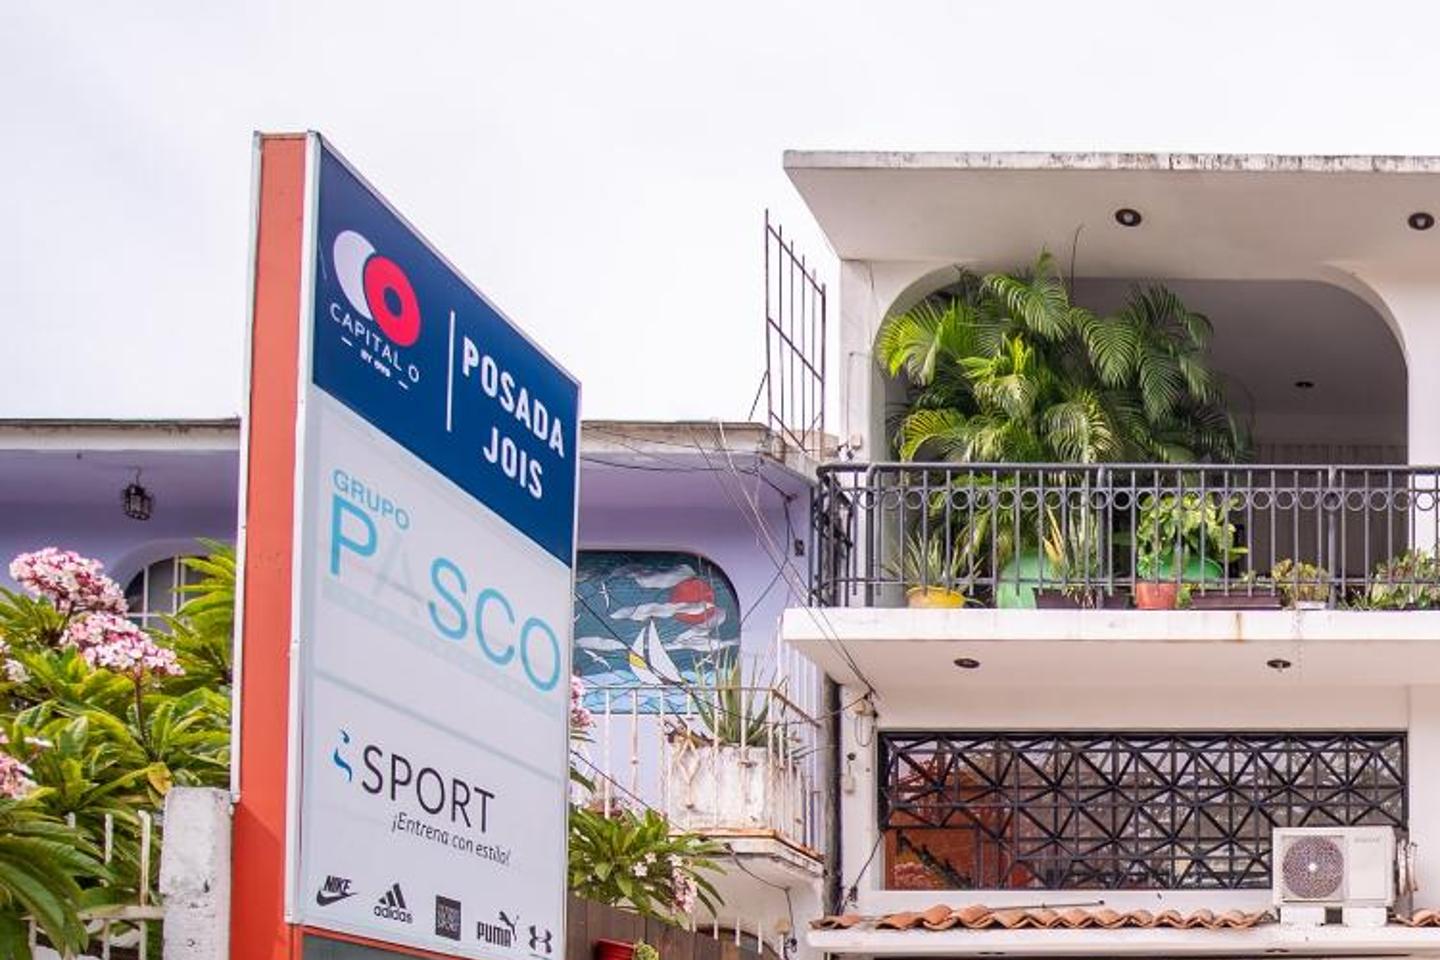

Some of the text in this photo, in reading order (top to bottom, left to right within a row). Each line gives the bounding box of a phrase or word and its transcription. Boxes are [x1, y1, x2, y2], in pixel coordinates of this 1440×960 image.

[330, 303, 419, 382] CAPITAL O
[463, 334, 564, 458] POSADA
[483, 427, 543, 499] JOIS
[334, 469, 410, 530] GRUPO
[331, 493, 561, 692] PASCO
[362, 745, 495, 833] SPORT
[452, 834, 473, 853] con
[323, 875, 351, 893] NIKE
[373, 905, 413, 924] adidas
[477, 921, 511, 948] PUMA
